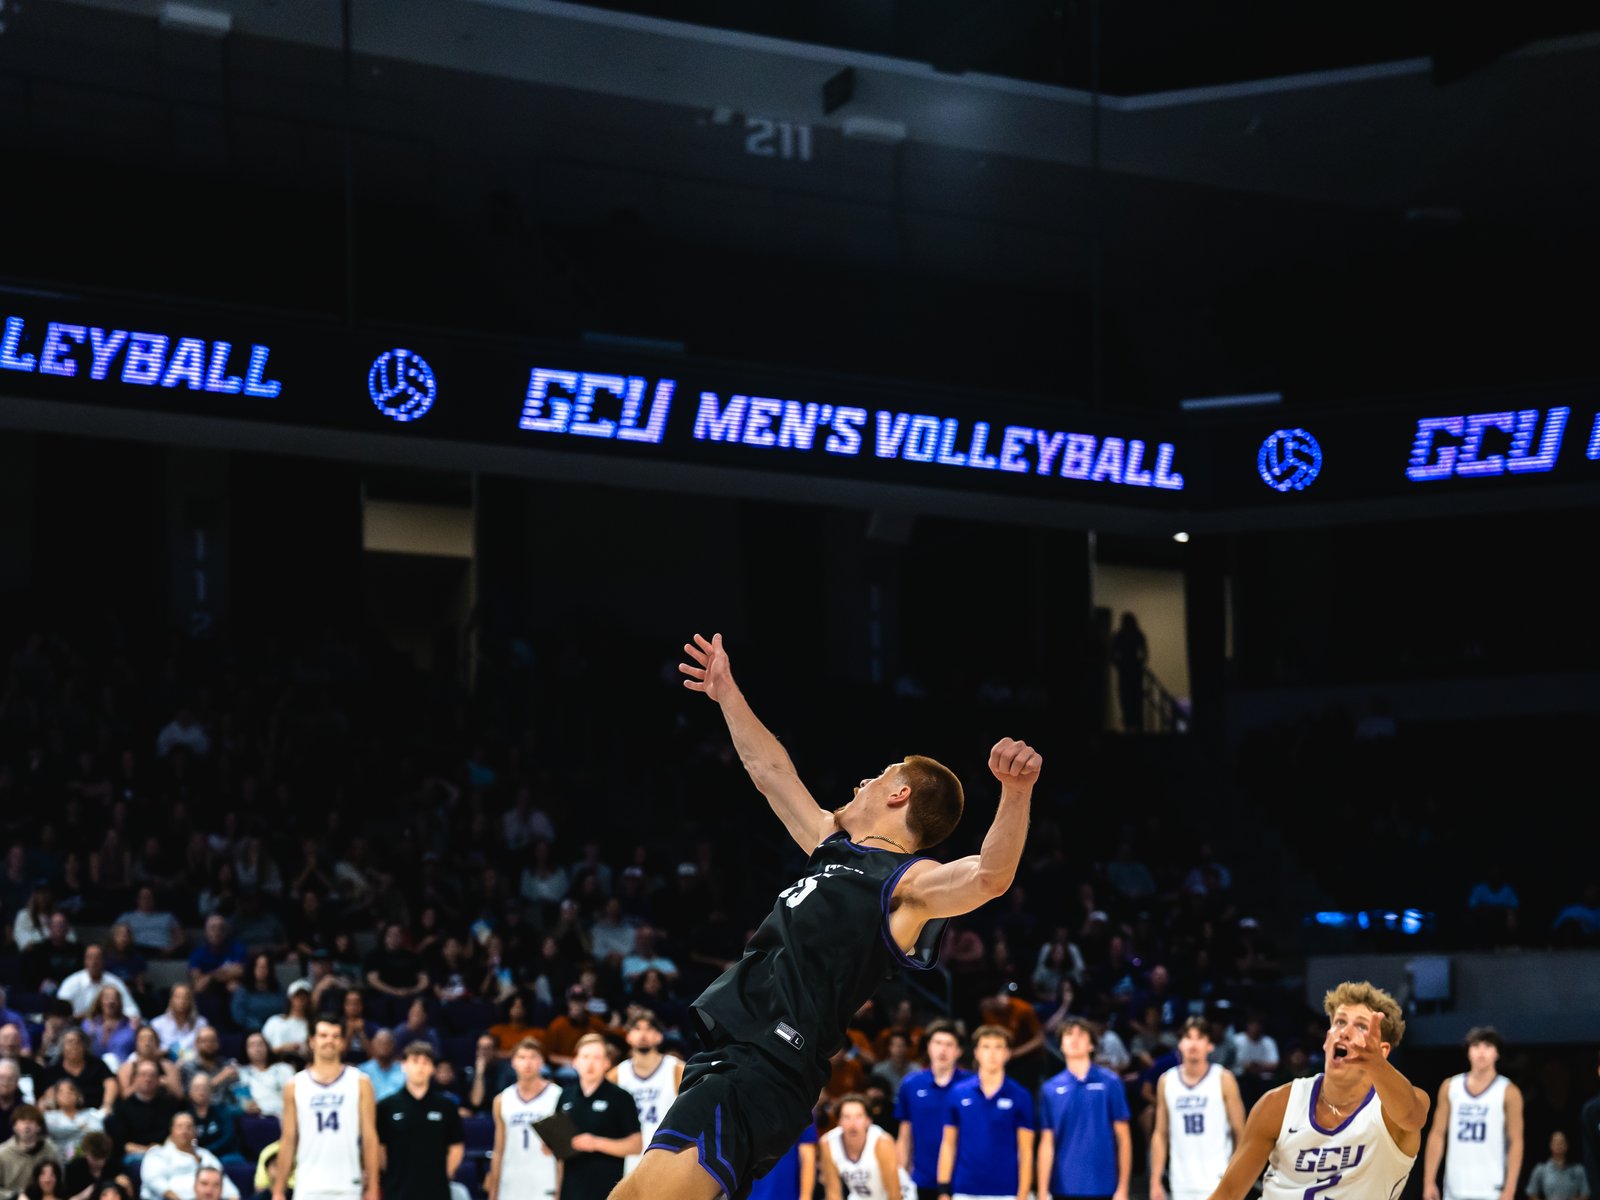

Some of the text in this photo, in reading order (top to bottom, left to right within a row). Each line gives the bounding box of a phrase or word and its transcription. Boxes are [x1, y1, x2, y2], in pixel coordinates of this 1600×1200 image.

[746, 117, 812, 162] 211
[0, 316, 281, 398] LEYBALL
[519, 367, 1184, 490] GCU MEN'S VOLLEYBALL
[1405, 406, 1570, 482] GCU
[315, 1110, 340, 1133] 14
[1184, 1113, 1204, 1135] 18
[1457, 1120, 1486, 1142] 20
[1295, 1144, 1366, 1173] GCU
